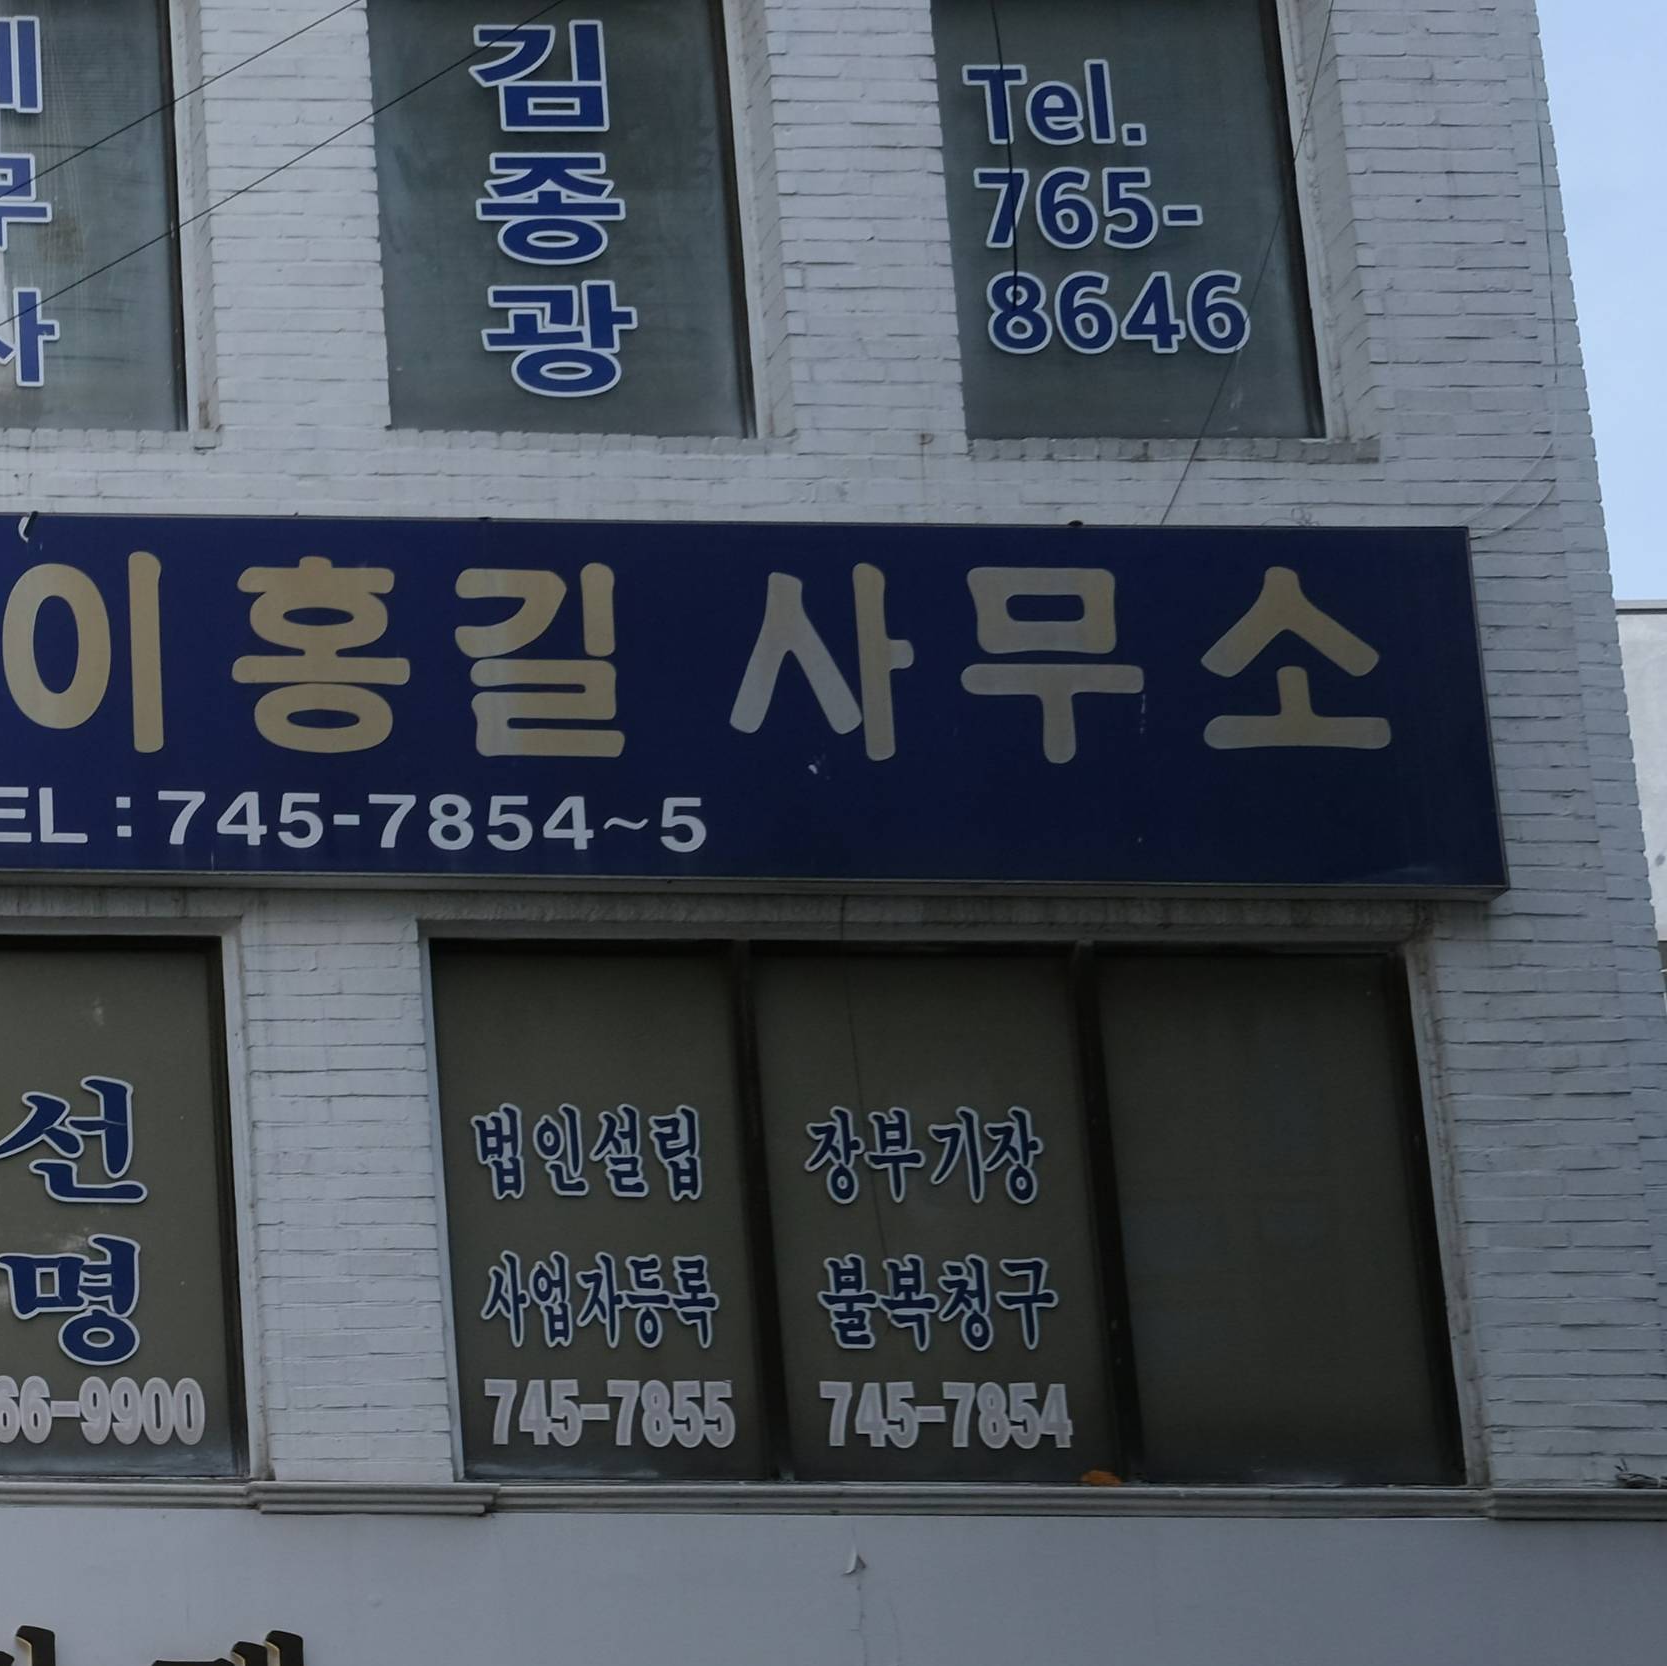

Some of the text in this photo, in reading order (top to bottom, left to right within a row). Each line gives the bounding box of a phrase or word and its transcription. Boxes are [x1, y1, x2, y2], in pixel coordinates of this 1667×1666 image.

[963, 58, 1147, 147] Tel.
[467, 19, 639, 398] 김종광
[974, 166, 1204, 253] 765-
[986, 269, 1251, 357] 8646
[1, 549, 626, 760] 이홍길
[730, 562, 1392, 766] 사무소
[470, 1101, 703, 1203] 법인설립
[805, 1105, 1044, 1205] 장부기장
[480, 1249, 720, 1350] 사업자등록
[818, 1253, 1059, 1353] 불복청구
[483, 1378, 736, 1450] 745-7855
[819, 1380, 1072, 1451] 745-7854
